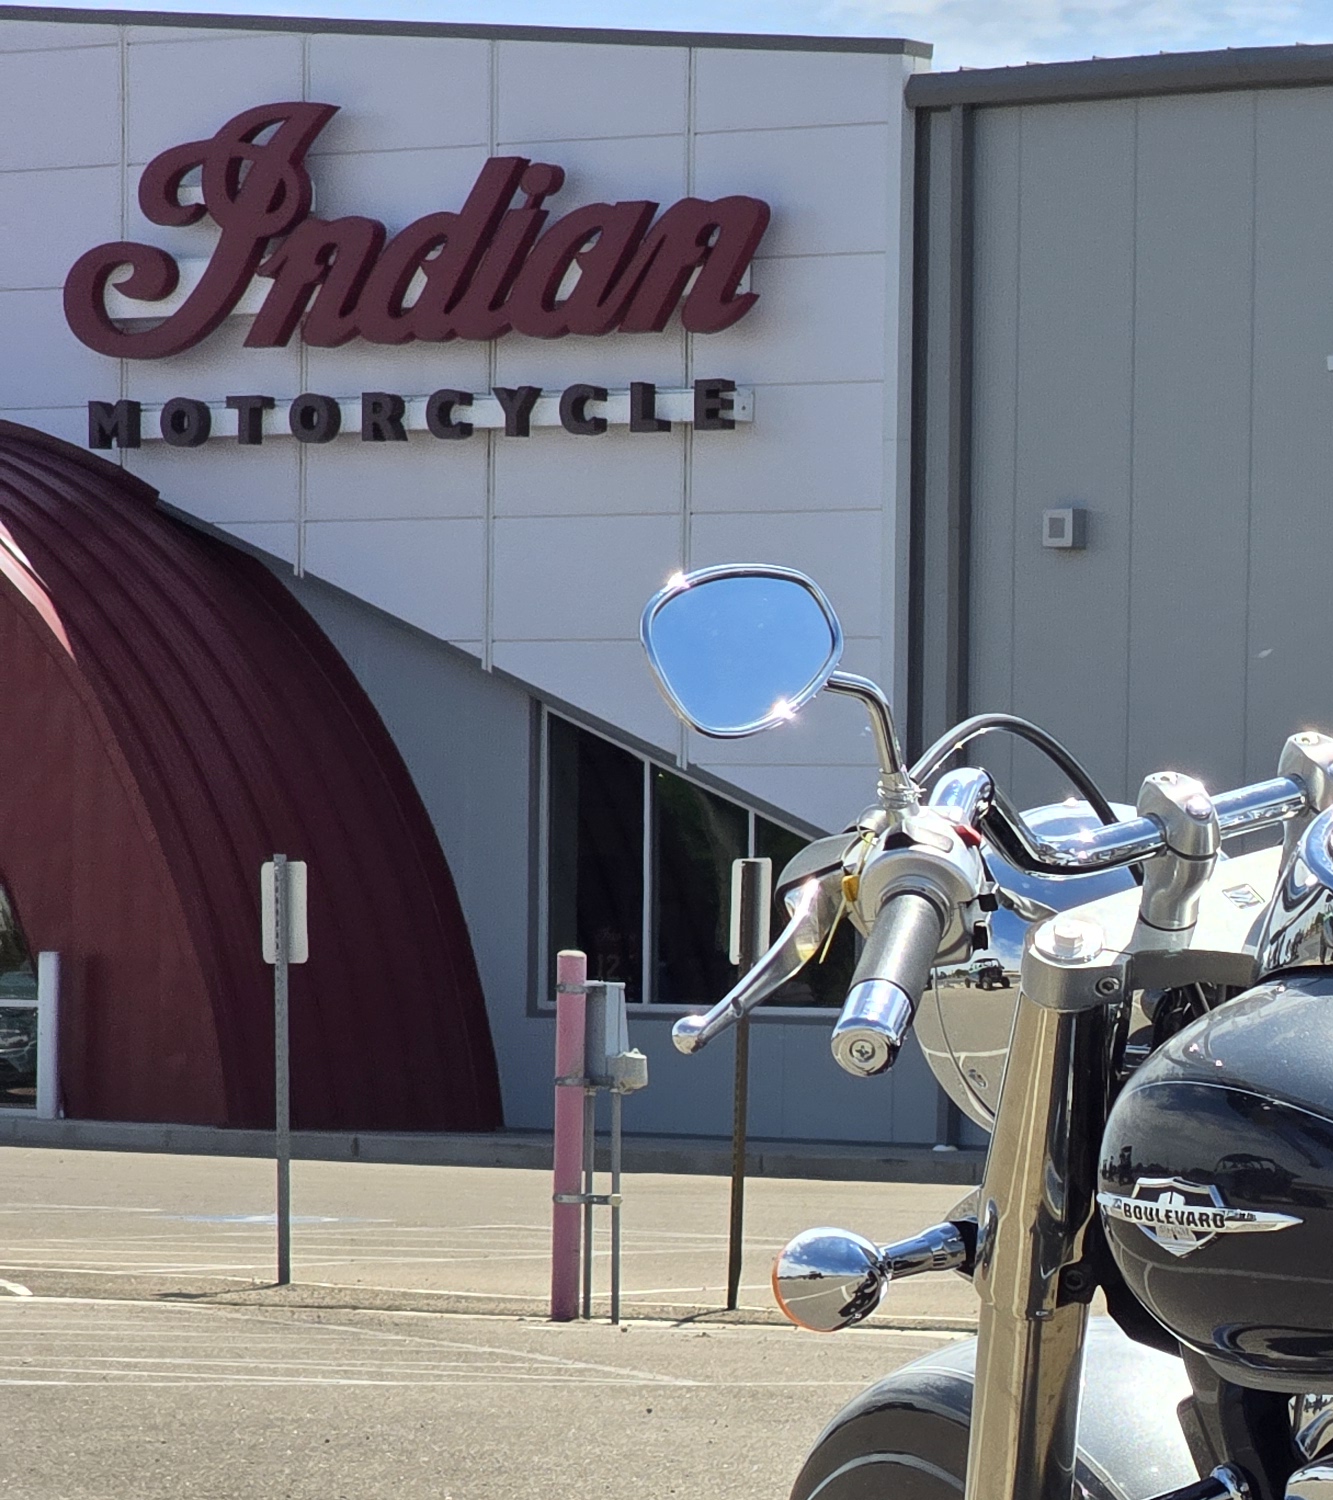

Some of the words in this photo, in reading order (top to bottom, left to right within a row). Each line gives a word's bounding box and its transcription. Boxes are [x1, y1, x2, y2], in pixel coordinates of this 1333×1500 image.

[63, 101, 772, 360] Indian
[88, 378, 737, 450] MOTORCYCLE
[1123, 1202, 1226, 1229] BOULEVARD
